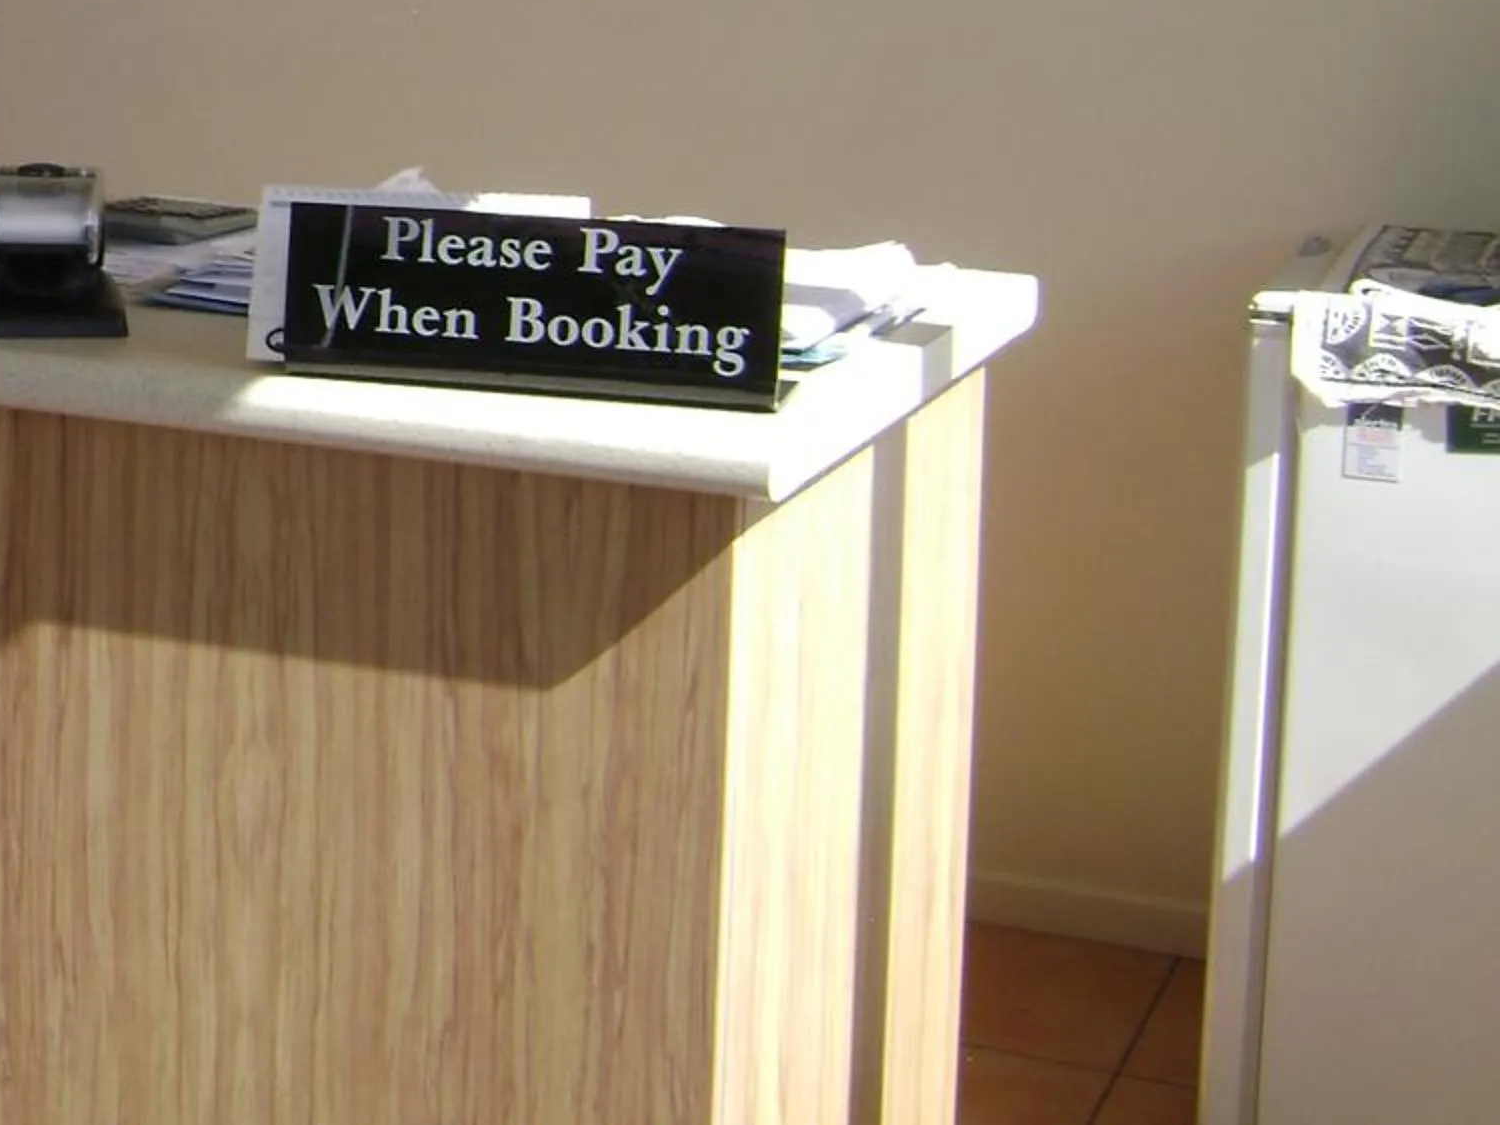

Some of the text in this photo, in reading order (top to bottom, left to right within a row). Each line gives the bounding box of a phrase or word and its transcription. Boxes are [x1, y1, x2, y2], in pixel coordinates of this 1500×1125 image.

[380, 216, 683, 296] Please Pay
[312, 283, 750, 377] When Booking
